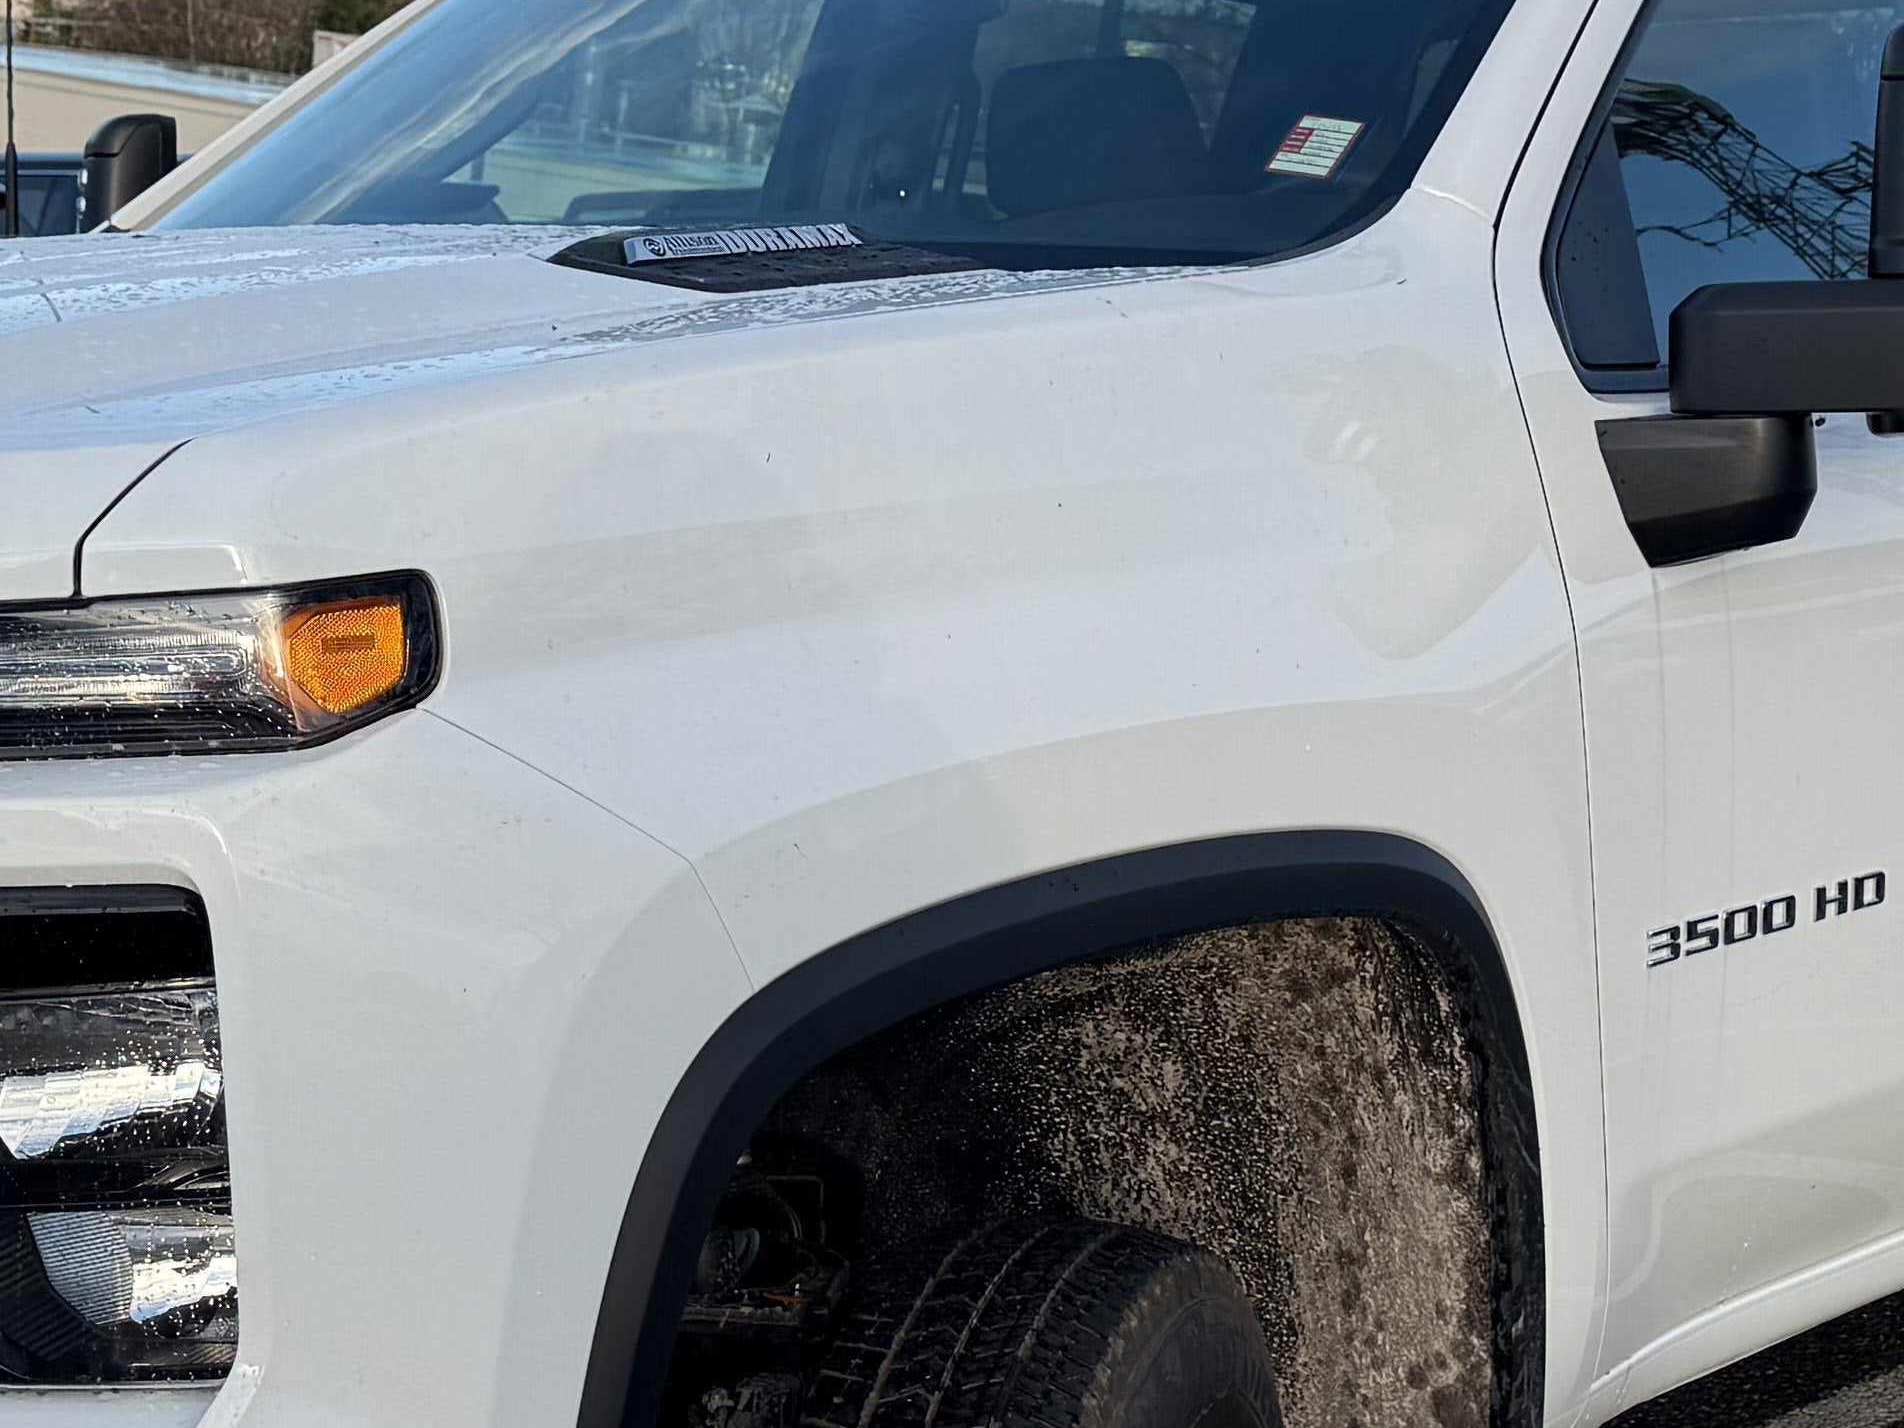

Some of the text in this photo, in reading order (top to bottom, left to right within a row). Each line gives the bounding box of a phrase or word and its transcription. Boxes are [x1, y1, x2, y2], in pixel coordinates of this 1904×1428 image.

[722, 223, 864, 254] DURAMAX
[1646, 871, 1886, 969] 3500 HD
